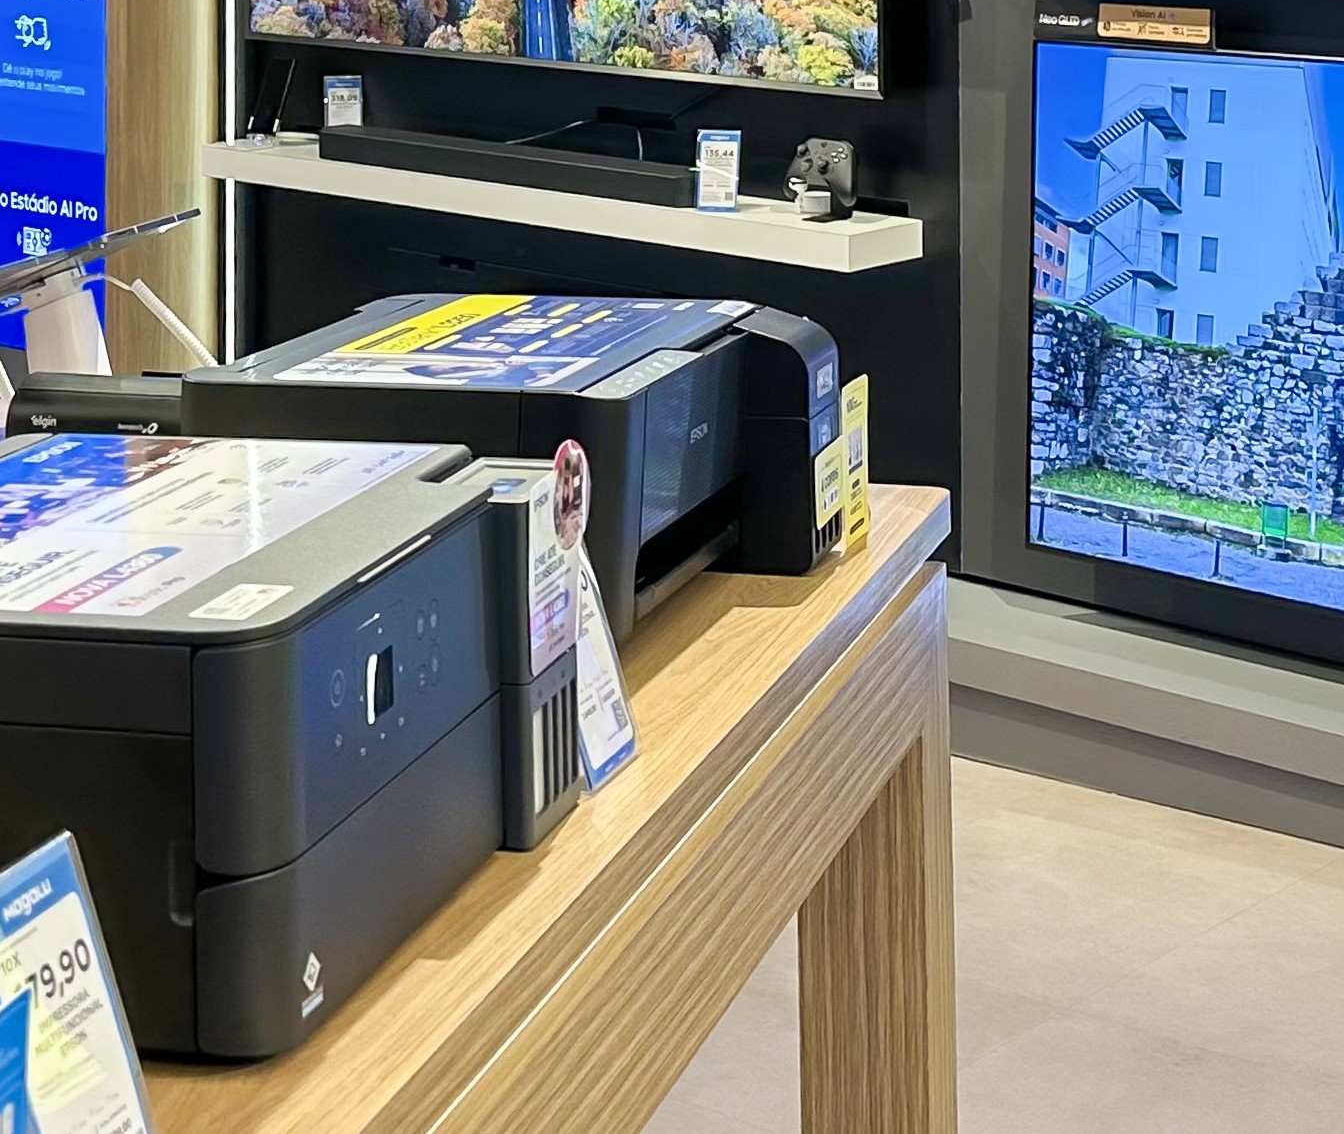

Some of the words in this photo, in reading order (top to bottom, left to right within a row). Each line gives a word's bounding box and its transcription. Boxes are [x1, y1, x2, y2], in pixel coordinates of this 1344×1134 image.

[10, 191, 57, 216] Estádio
[60, 198, 72, 218] AI
[75, 202, 98, 222] Pro
[14, 938, 92, 1010] 79,90
